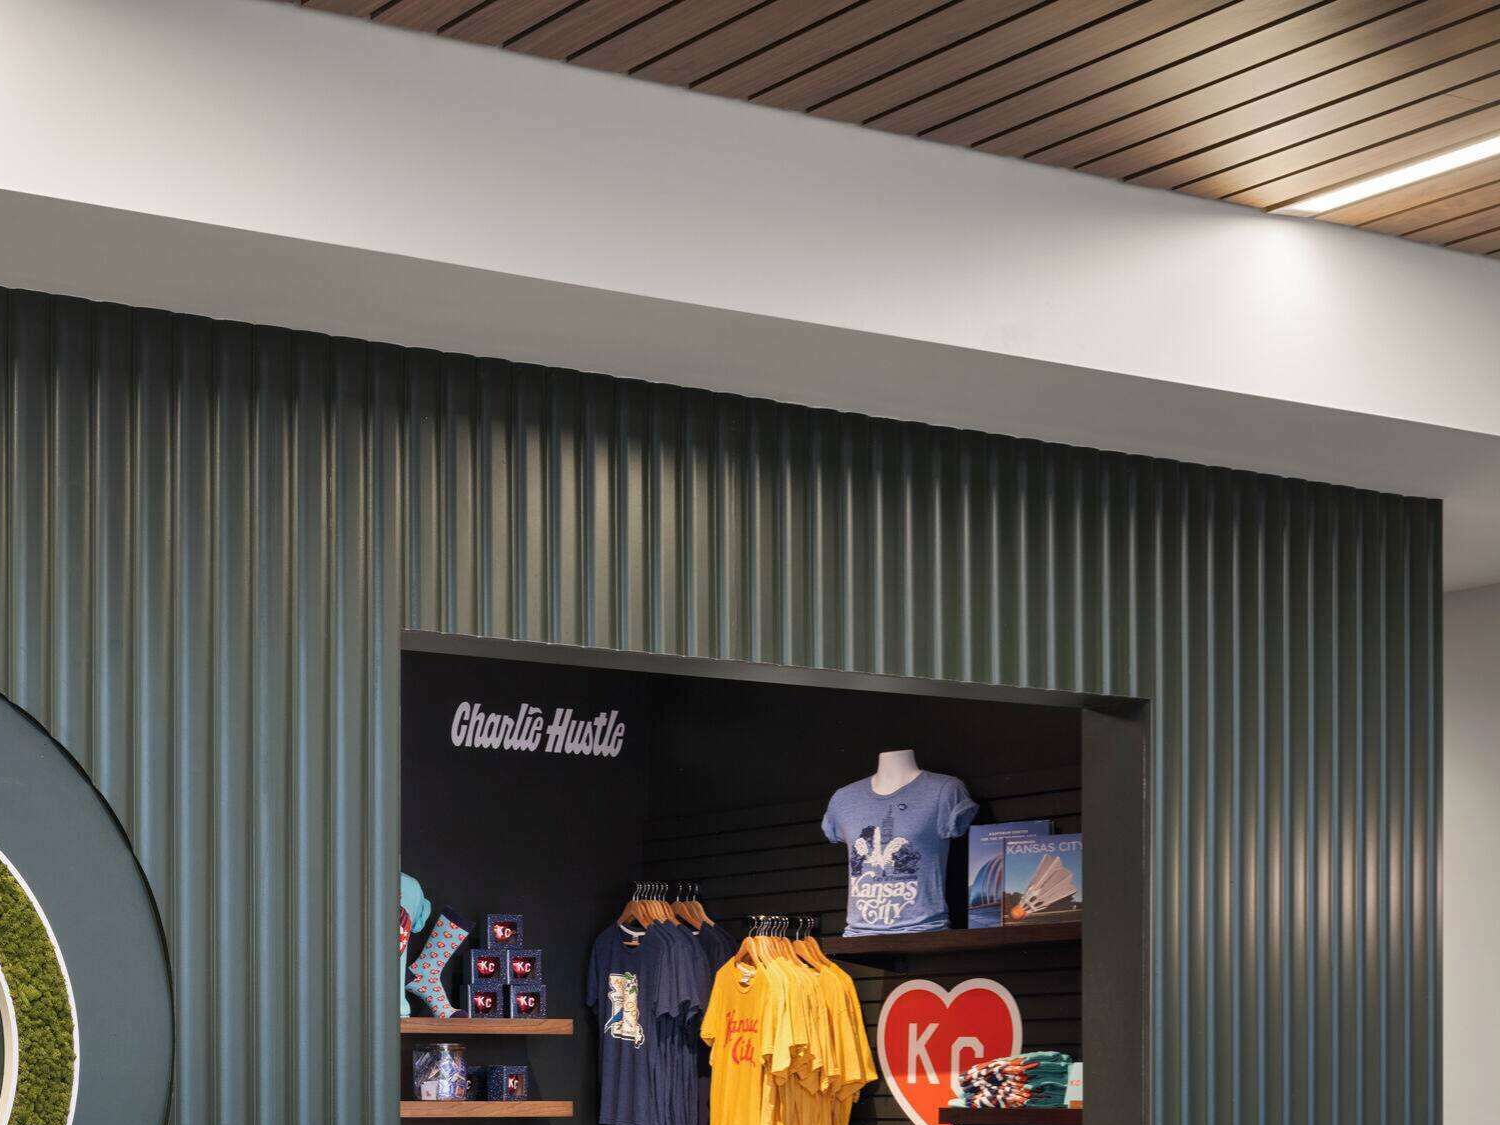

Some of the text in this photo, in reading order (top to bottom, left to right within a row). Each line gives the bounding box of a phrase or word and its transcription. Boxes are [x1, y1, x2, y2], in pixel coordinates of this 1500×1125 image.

[451, 701, 626, 758] Charlie Hustle
[1006, 842, 1056, 855] KANSAS
[850, 871, 918, 901] Kansas
[856, 898, 916, 925] City
[479, 960, 496, 973] KC
[514, 961, 532, 973] KC
[475, 996, 493, 1008] KC
[518, 996, 535, 1007] KC
